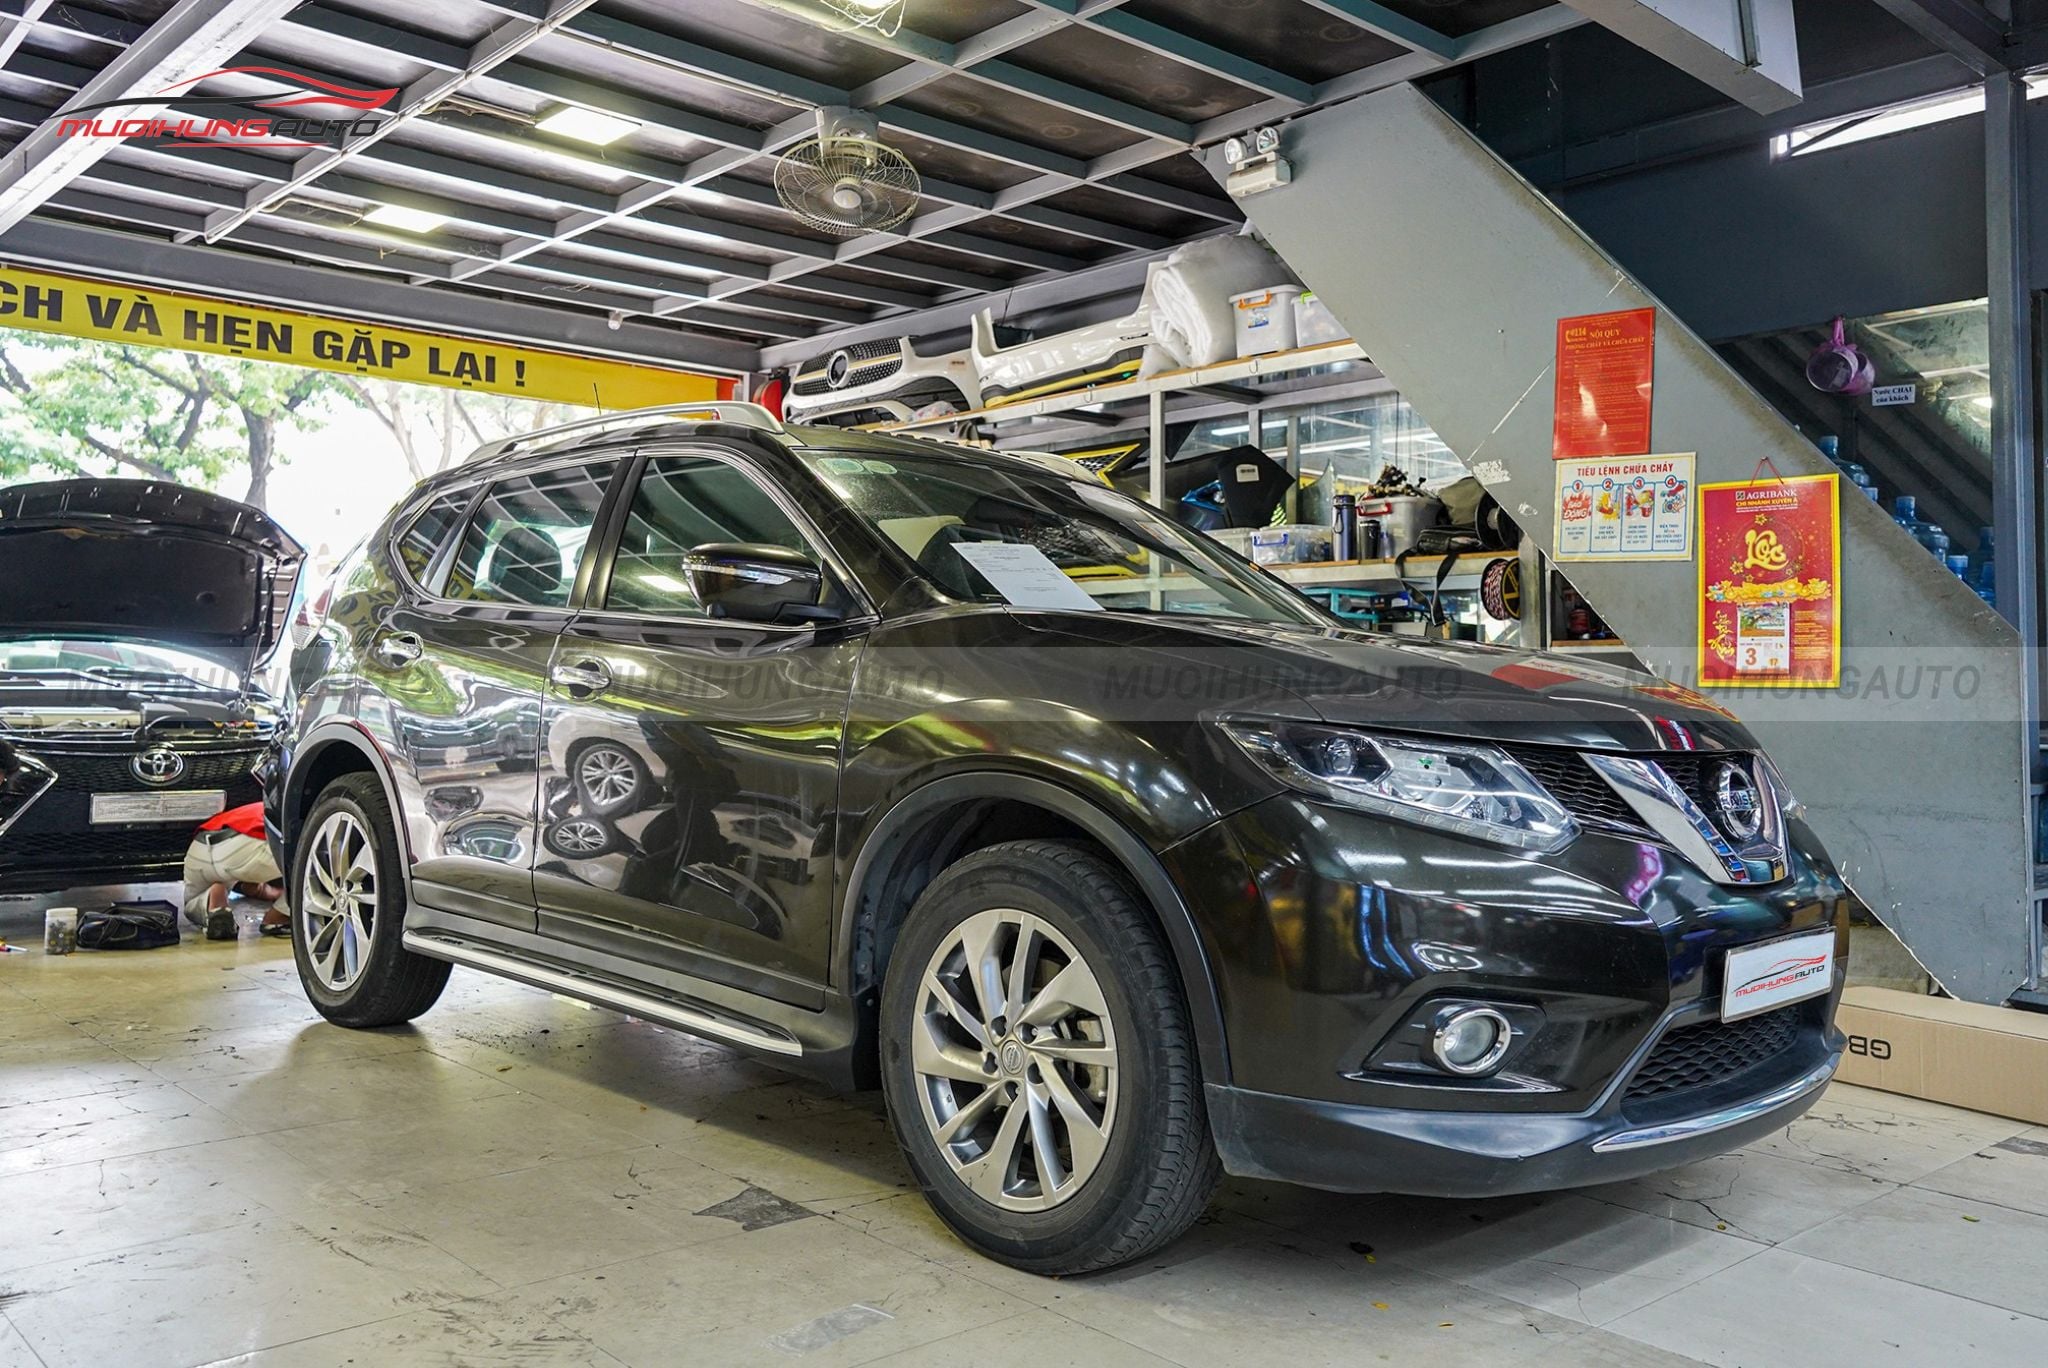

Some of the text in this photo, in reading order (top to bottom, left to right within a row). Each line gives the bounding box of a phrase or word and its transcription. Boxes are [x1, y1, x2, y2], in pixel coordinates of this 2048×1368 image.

[86, 294, 163, 337] VÀ
[183, 309, 293, 354] HẸN
[312, 328, 411, 372] GẶP
[428, 346, 496, 386] LẠI
[515, 359, 525, 387] !
[1605, 480, 1611, 489] 2
[1636, 479, 1642, 488] 3
[1746, 489, 1798, 500] AGRIBANK
[1745, 647, 1757, 666] 3
